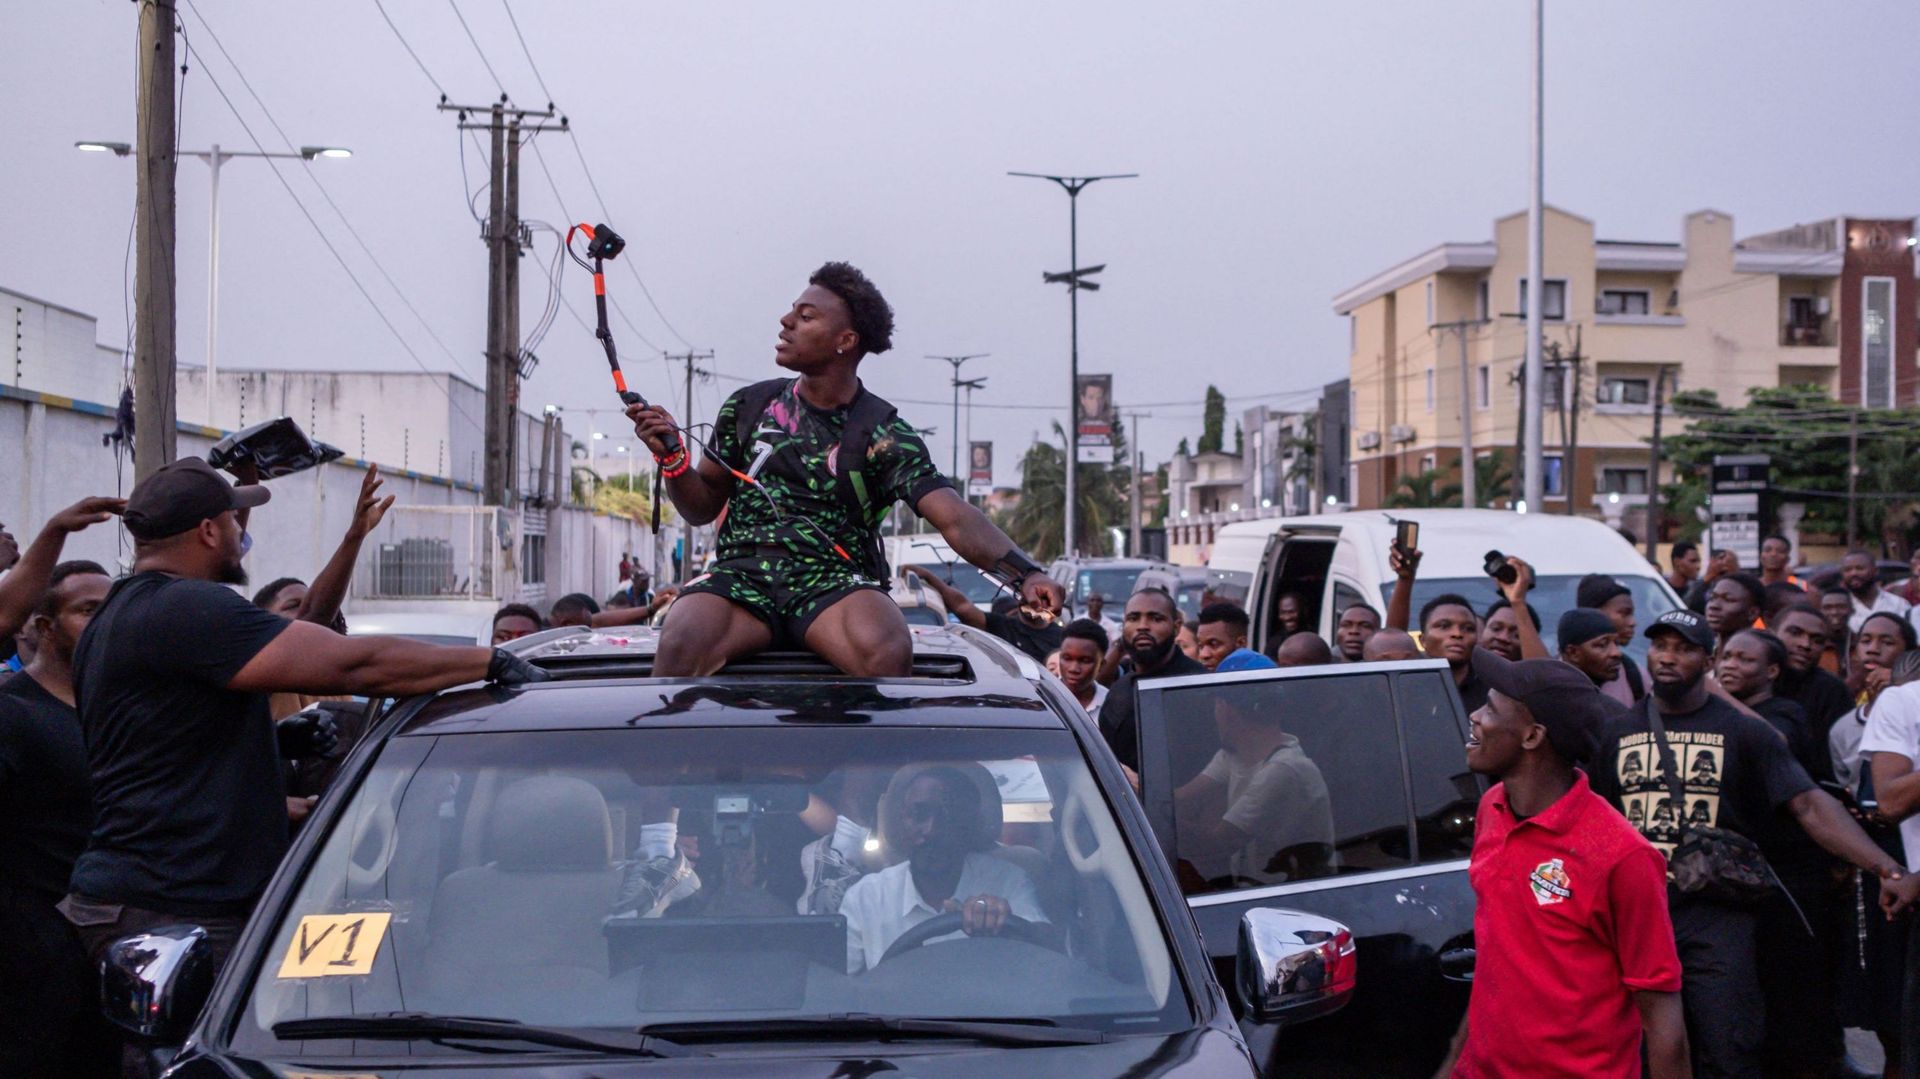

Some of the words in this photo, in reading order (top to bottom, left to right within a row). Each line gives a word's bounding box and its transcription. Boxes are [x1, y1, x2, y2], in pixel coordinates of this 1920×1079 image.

[747, 440, 774, 479] 7
[1619, 732, 1649, 748] MOODS
[1665, 731, 1692, 743] ARTH
[1693, 732, 1724, 745] VADER
[299, 918, 366, 967] V1
